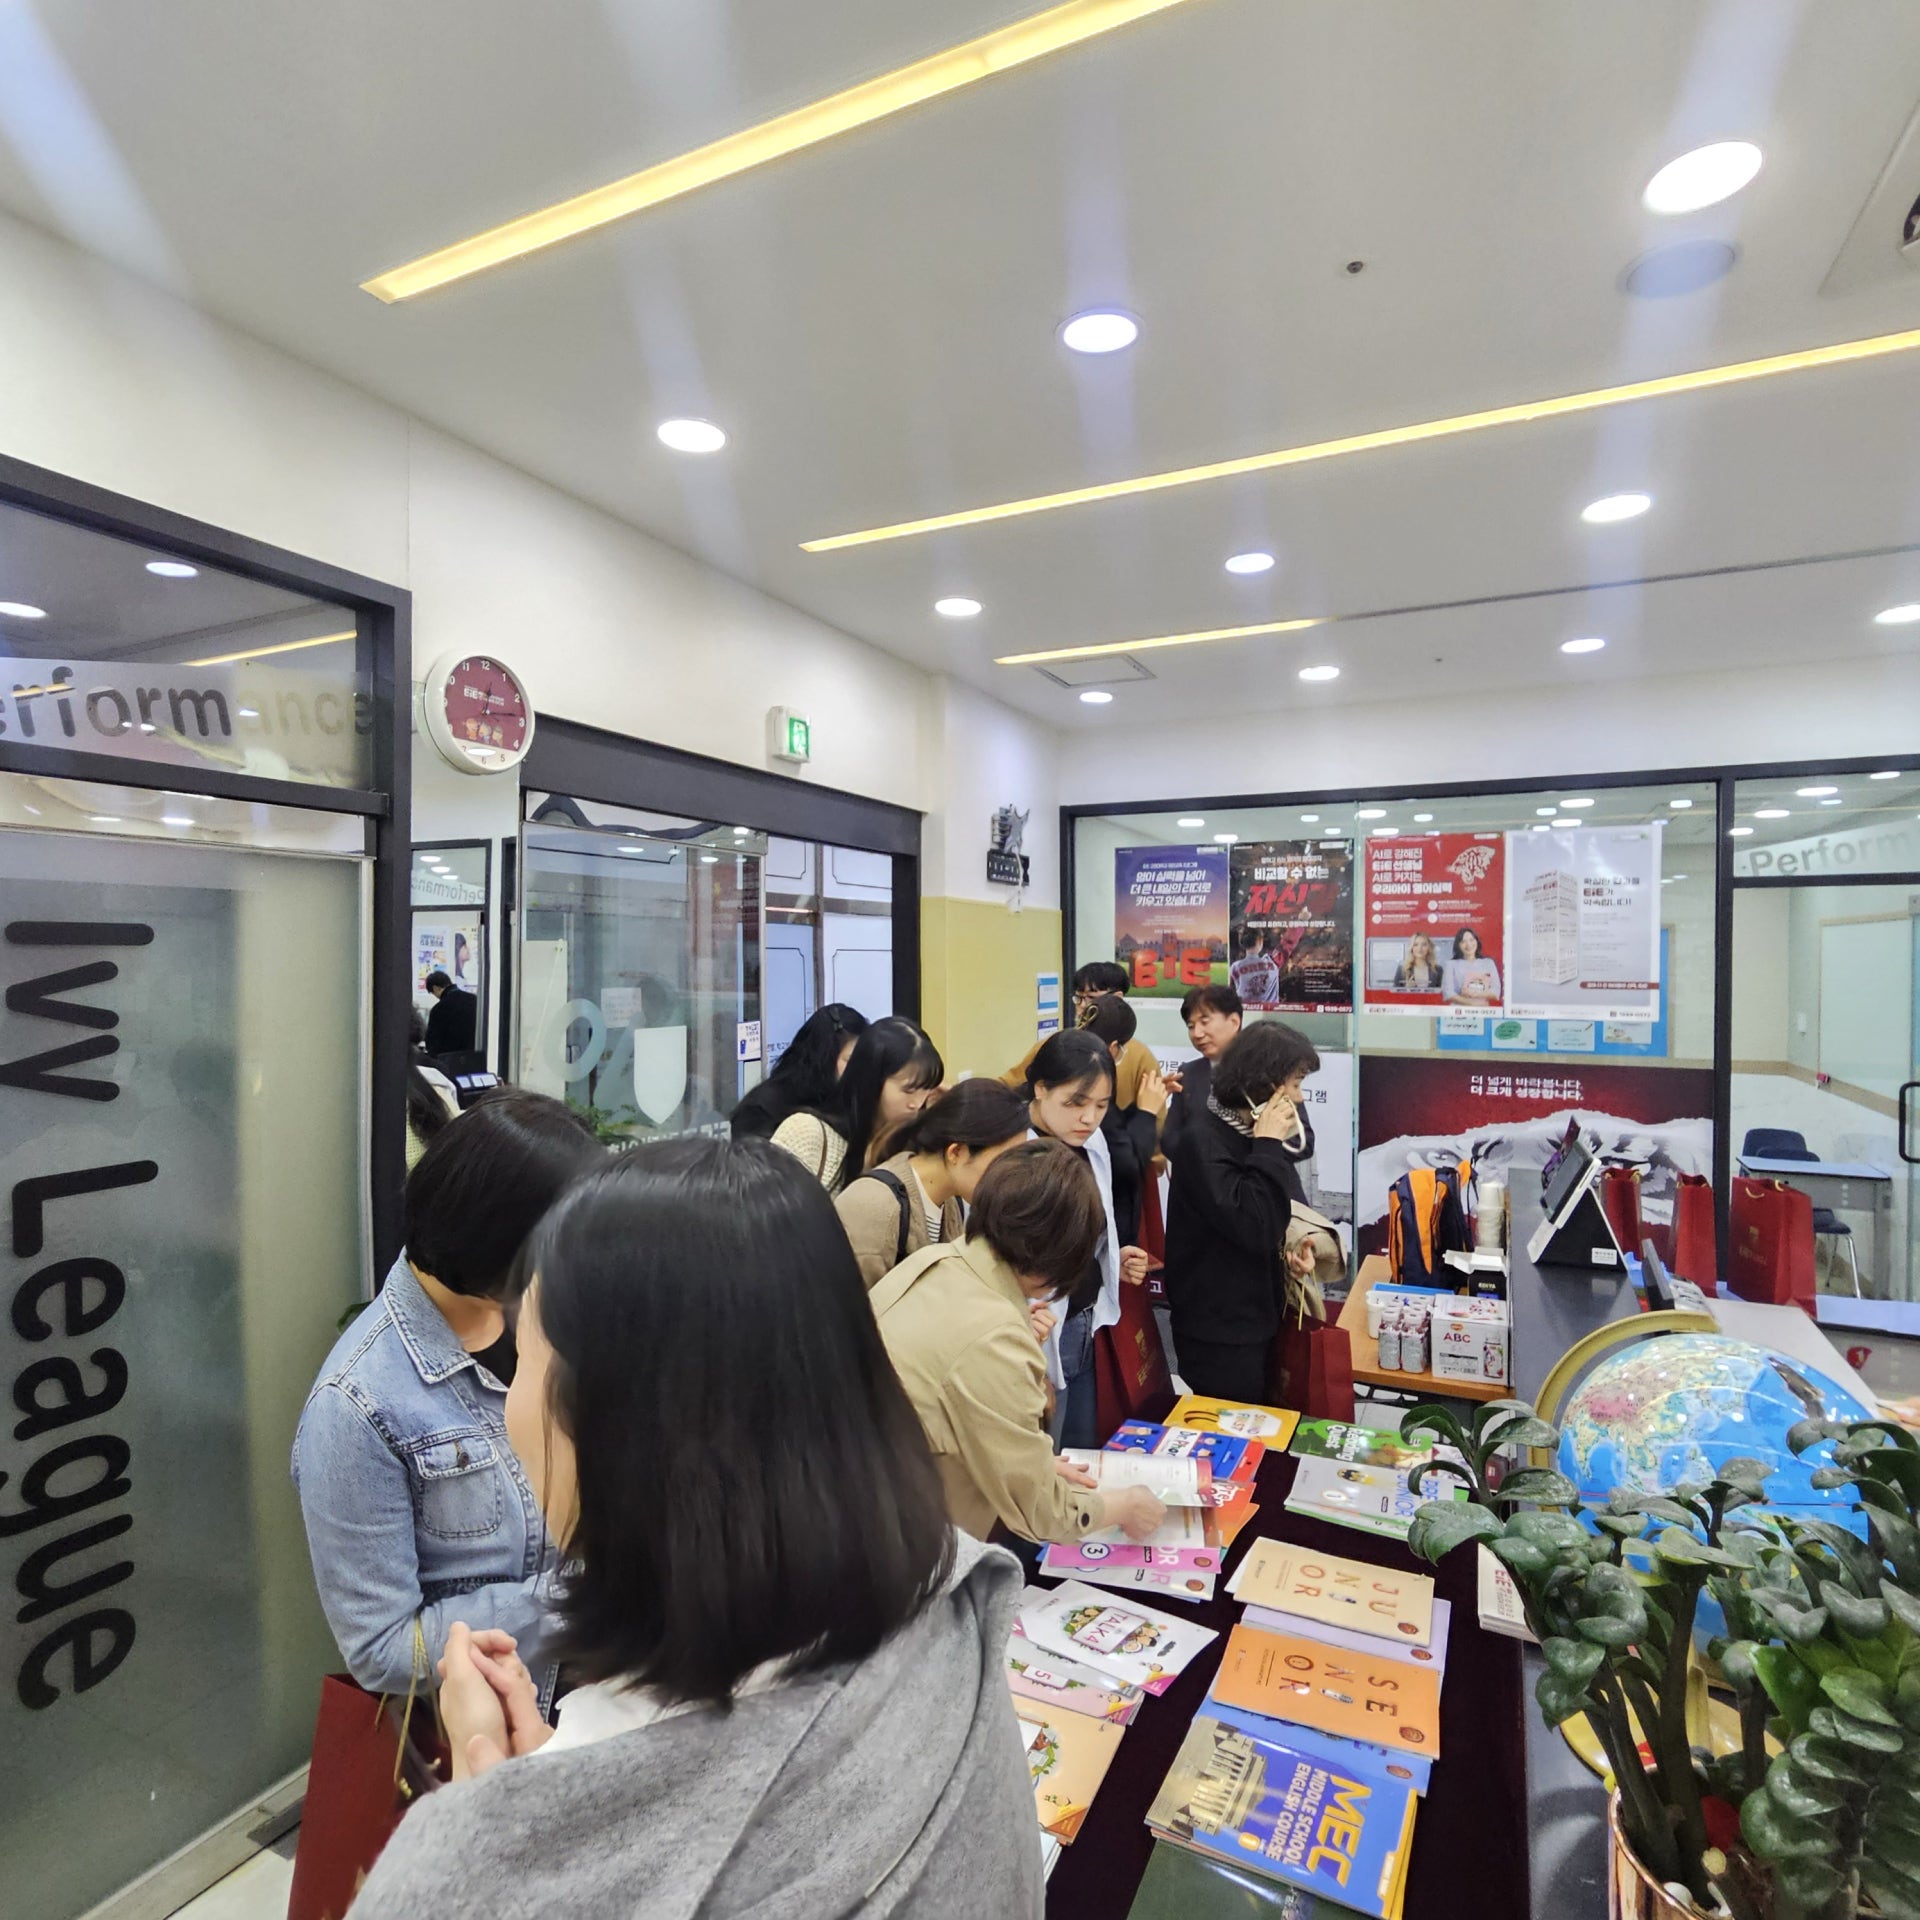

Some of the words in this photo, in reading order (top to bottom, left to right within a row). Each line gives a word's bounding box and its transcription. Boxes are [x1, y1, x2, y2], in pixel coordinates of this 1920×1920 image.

[1254, 867, 1289, 881] 비교할
[1290, 866, 1303, 879] 수
[1305, 865, 1329, 879] 없는
[1470, 1085, 1483, 1096] 더
[1486, 1086, 1512, 1097] 크게
[1471, 1075, 1483, 1085] 더
[1443, 1331, 1472, 1344] ABC
[0, 1159, 159, 1711] League
[1086, 1546, 1104, 1555] 3
[1282, 1762, 1312, 1812] ENGLISH
[1302, 1768, 1330, 1817] MIDDLE
[1265, 1810, 1295, 1863] COURSE
[1283, 1814, 1315, 1865] SCHOOL
[1306, 1775, 1373, 1889] MEC
